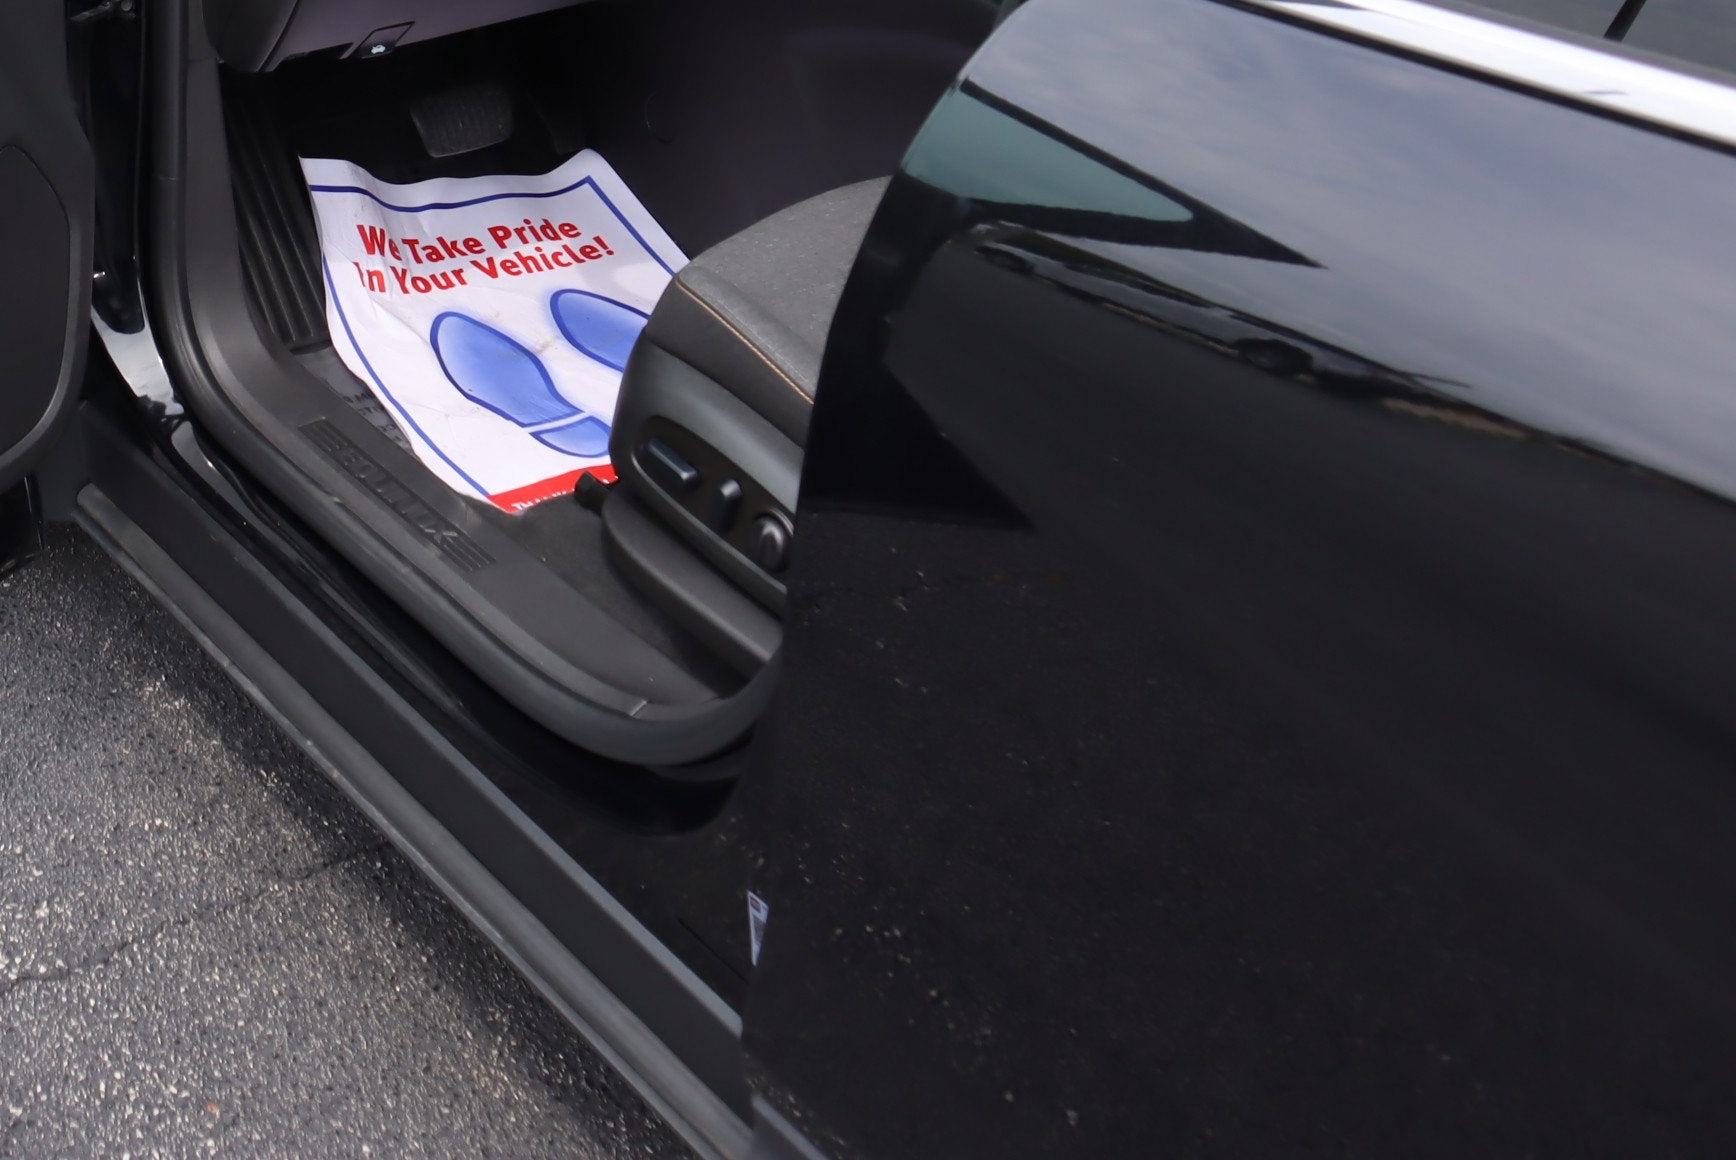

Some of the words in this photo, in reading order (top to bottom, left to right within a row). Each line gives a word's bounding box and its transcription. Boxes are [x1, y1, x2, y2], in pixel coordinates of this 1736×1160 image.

[353, 261, 386, 293] In
[389, 264, 468, 295] Your
[470, 235, 615, 280] Vehicle!
[356, 224, 402, 261] We
[401, 236, 487, 265] Take
[487, 218, 582, 250] Pride
